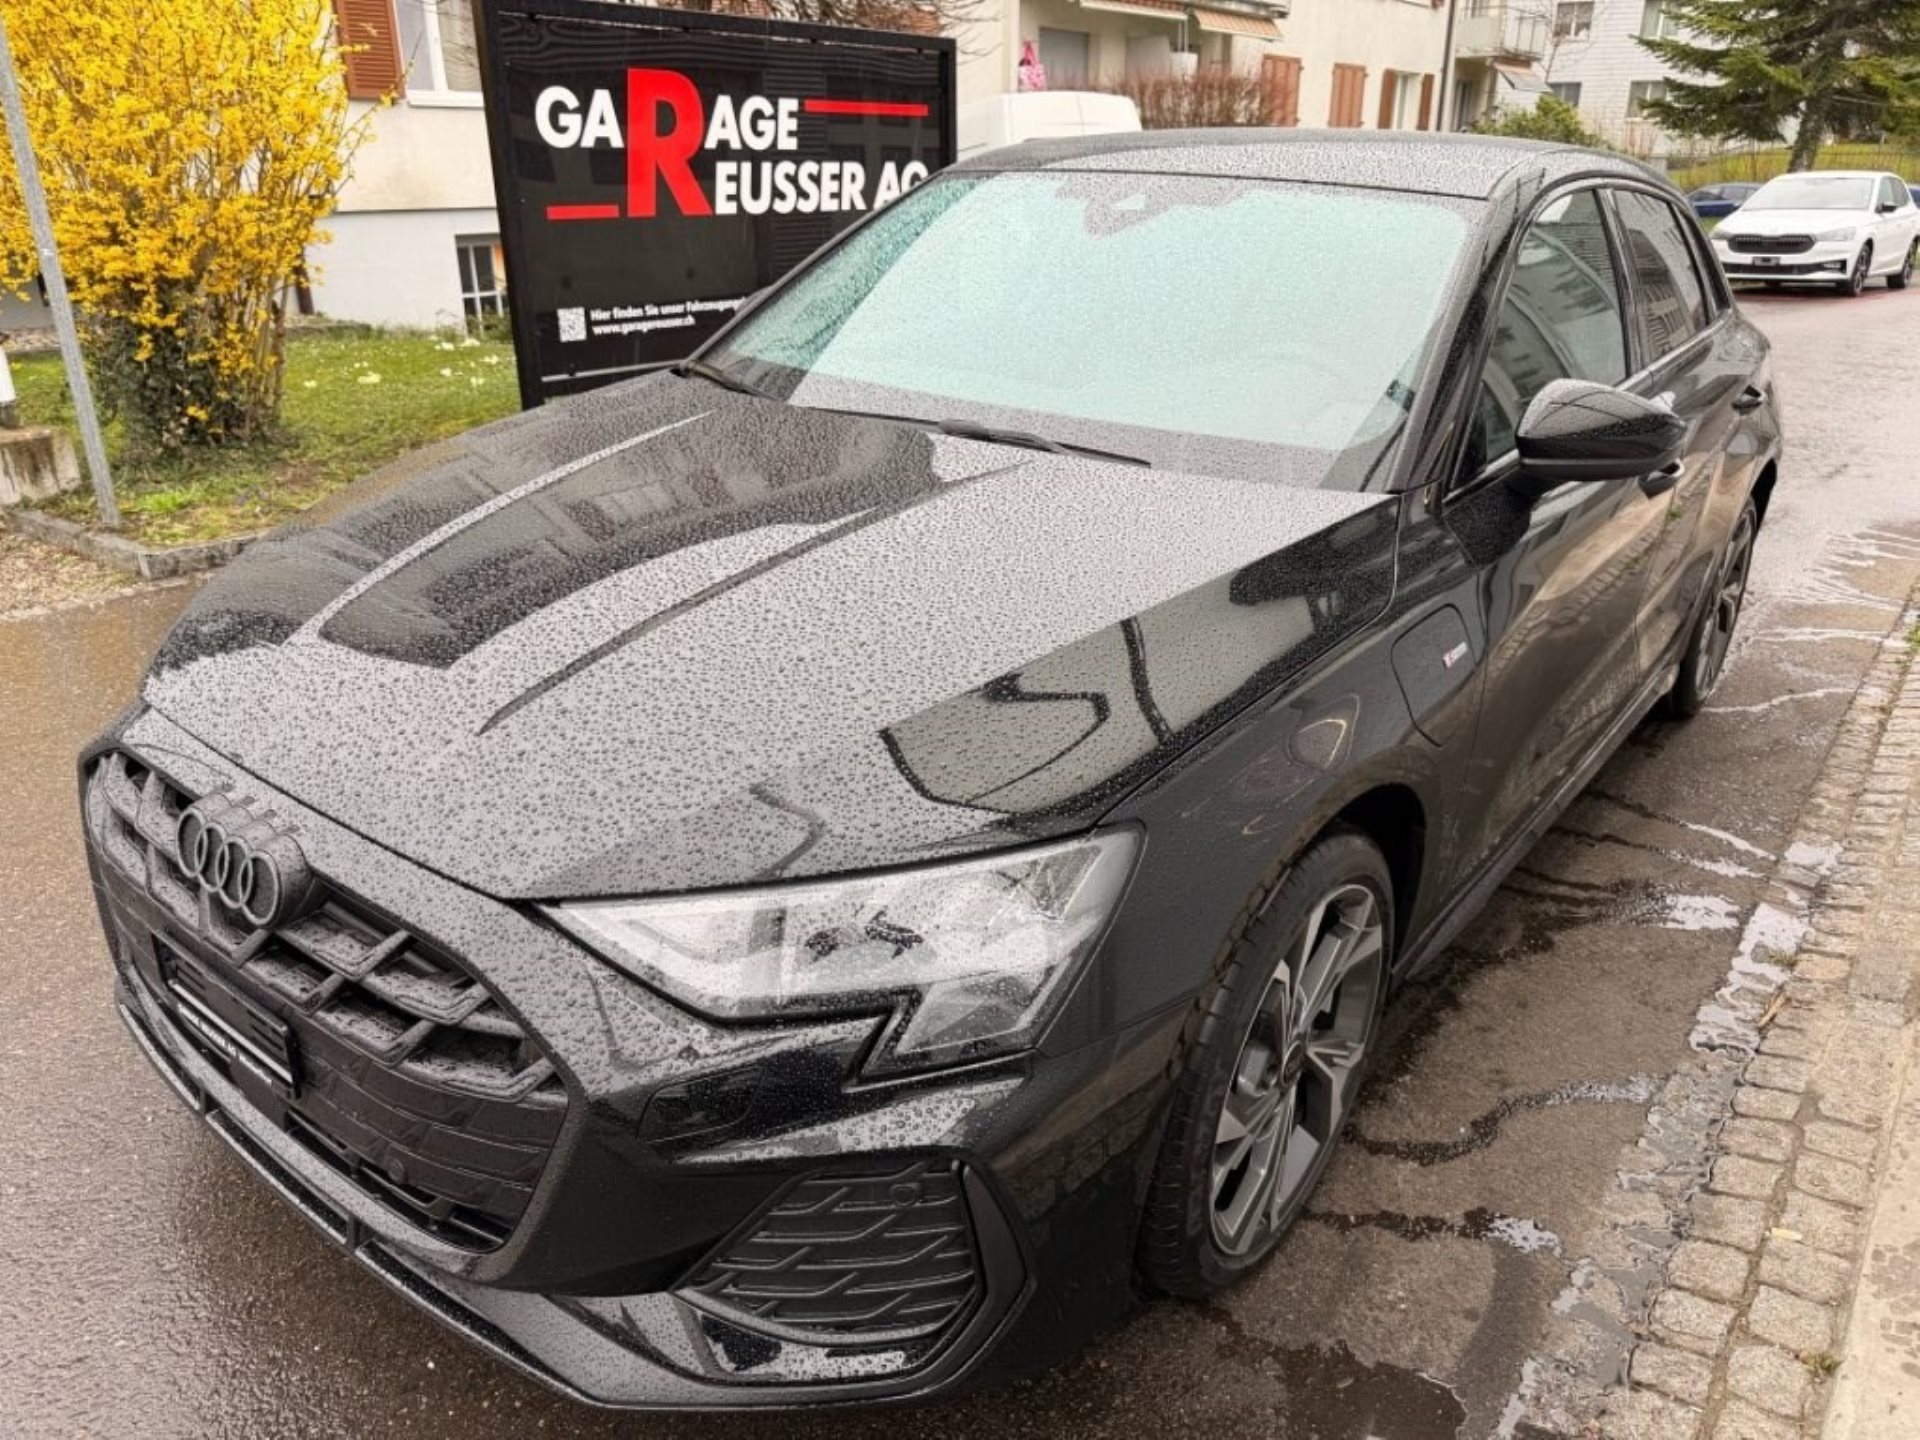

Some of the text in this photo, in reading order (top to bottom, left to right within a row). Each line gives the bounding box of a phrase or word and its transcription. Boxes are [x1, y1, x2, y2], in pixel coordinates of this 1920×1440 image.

[590, 308, 612, 321] Hier
[612, 305, 644, 320] finden
[645, 303, 660, 317] Sie
[660, 303, 685, 316] unser
